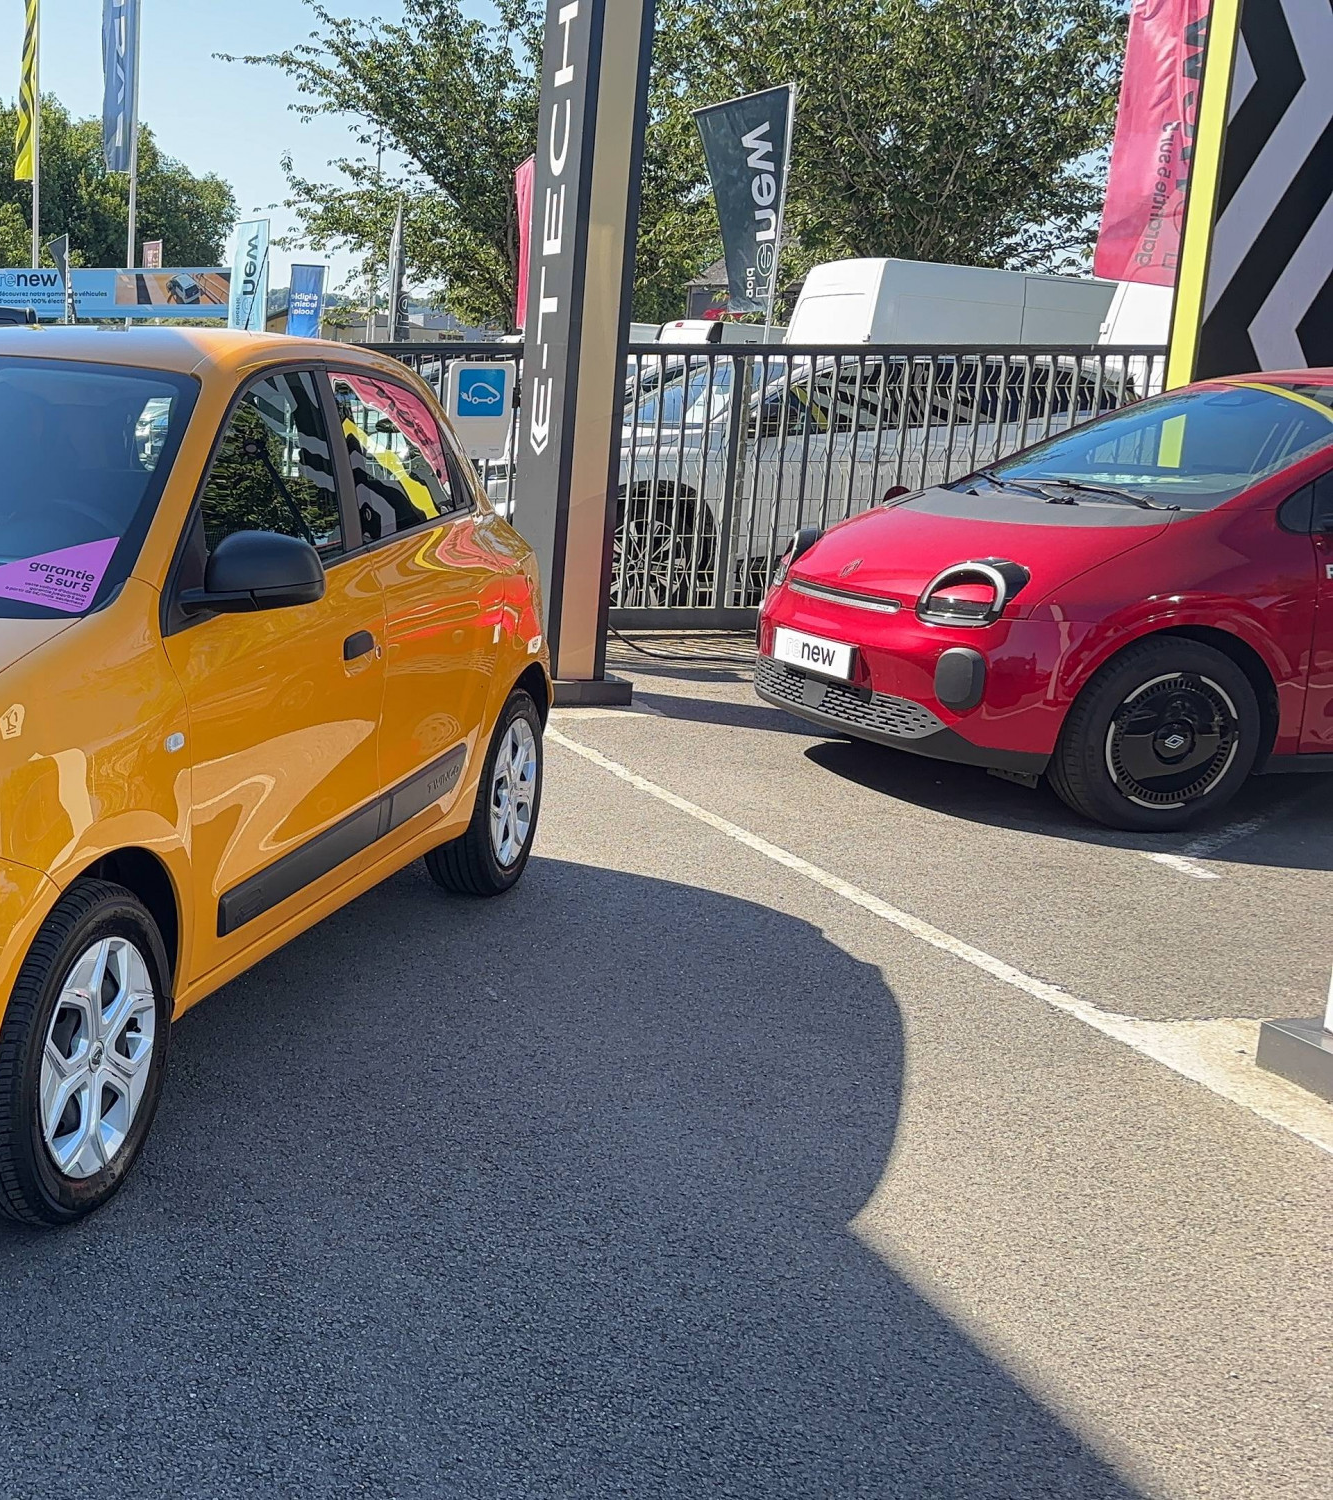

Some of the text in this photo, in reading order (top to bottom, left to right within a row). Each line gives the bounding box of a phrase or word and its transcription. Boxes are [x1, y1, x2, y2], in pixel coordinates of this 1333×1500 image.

[530, 4, 578, 456] E-TECH
[29, 562, 95, 582] garantie
[44, 574, 92, 592] 5 sur 5
[785, 637, 836, 667] renew
